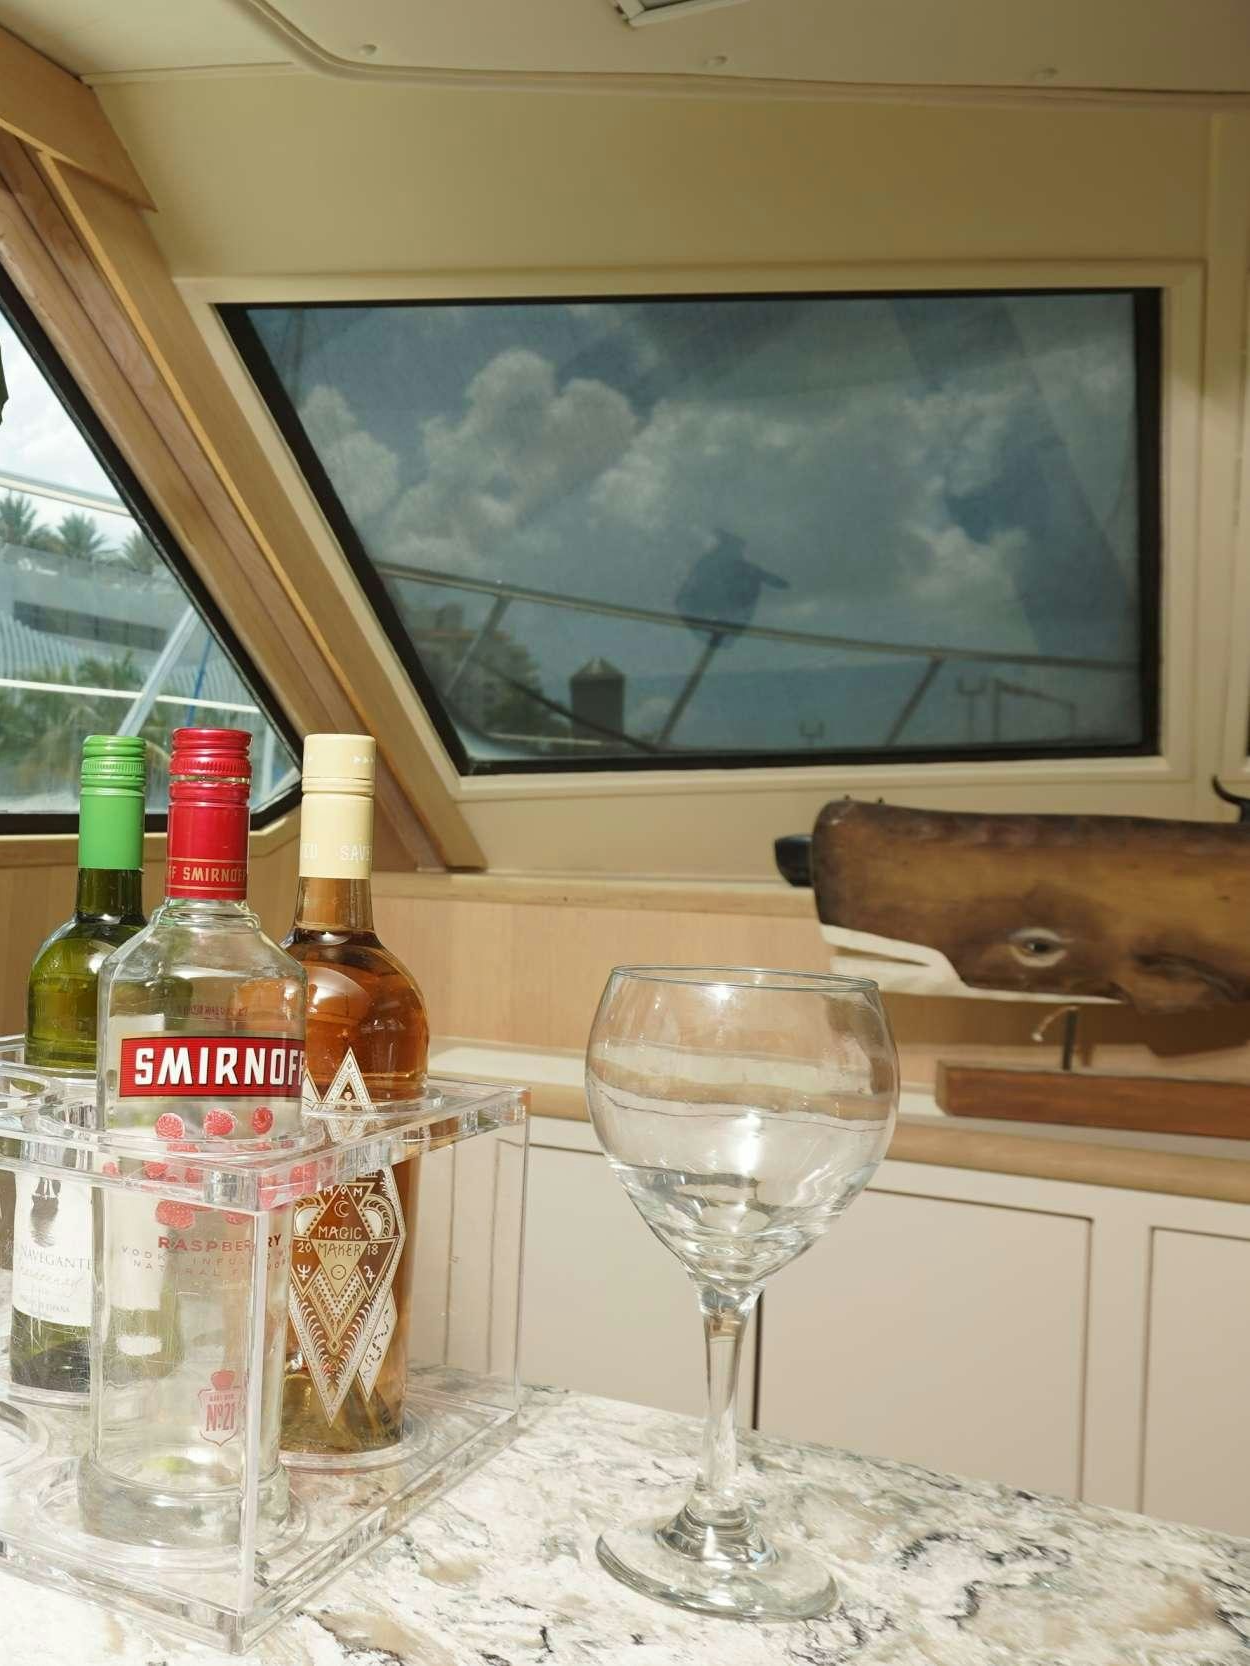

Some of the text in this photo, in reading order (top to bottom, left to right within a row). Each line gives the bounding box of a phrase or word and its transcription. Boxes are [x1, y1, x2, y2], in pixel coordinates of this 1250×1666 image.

[318, 1226, 362, 1239] MAGIC
[297, 1242, 312, 1253] 20
[317, 1242, 361, 1258] MAKER
[367, 1243, 379, 1256] 18
